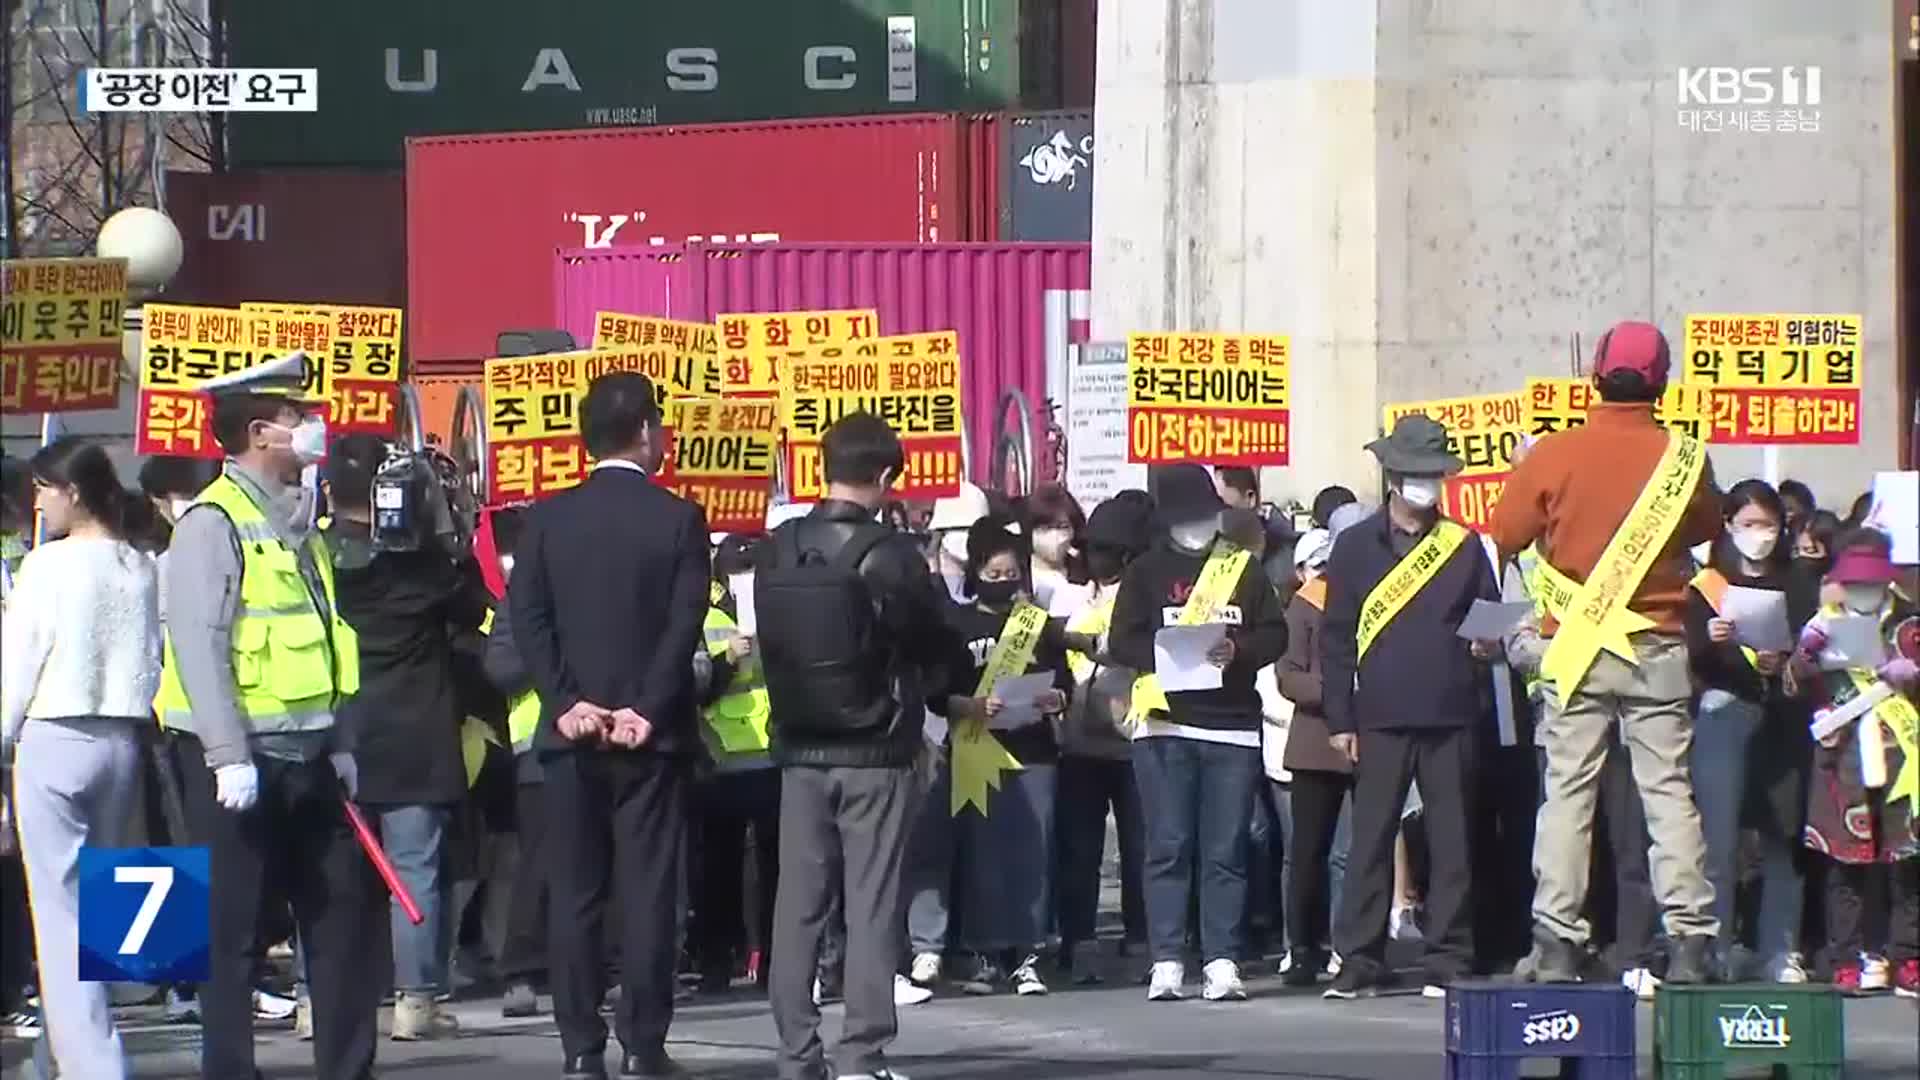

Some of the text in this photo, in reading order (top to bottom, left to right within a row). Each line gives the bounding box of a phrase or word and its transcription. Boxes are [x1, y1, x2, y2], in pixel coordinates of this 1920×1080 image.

[385, 46, 857, 92] UASC
[207, 204, 265, 241] CAI
[150, 310, 190, 341] 침묵의
[276, 319, 329, 352] 발암물질
[338, 312, 398, 337] 참았다
[600, 317, 657, 346] 무용지물
[1692, 319, 1857, 346] 주민생존권 위협하는
[1133, 337, 1169, 363] 주민
[1178, 338, 1215, 365] 건강
[1224, 339, 1241, 364] 좀
[1249, 339, 1285, 366] 먹는
[35, 354, 119, 404] 죽인다
[149, 344, 324, 395] 한국타어
[491, 359, 576, 392] 즉각적인
[793, 361, 956, 392] 한국타이어 필요없다
[1133, 366, 1285, 404] 한국타이어는
[147, 395, 206, 451] 즉각
[719, 404, 776, 432] 살겠다
[1746, 395, 1856, 437] 퇴출하라!
[495, 444, 594, 497] 확보
[1523, 1013, 1580, 1045] Cass
[1719, 1016, 1792, 1043] TERRA
